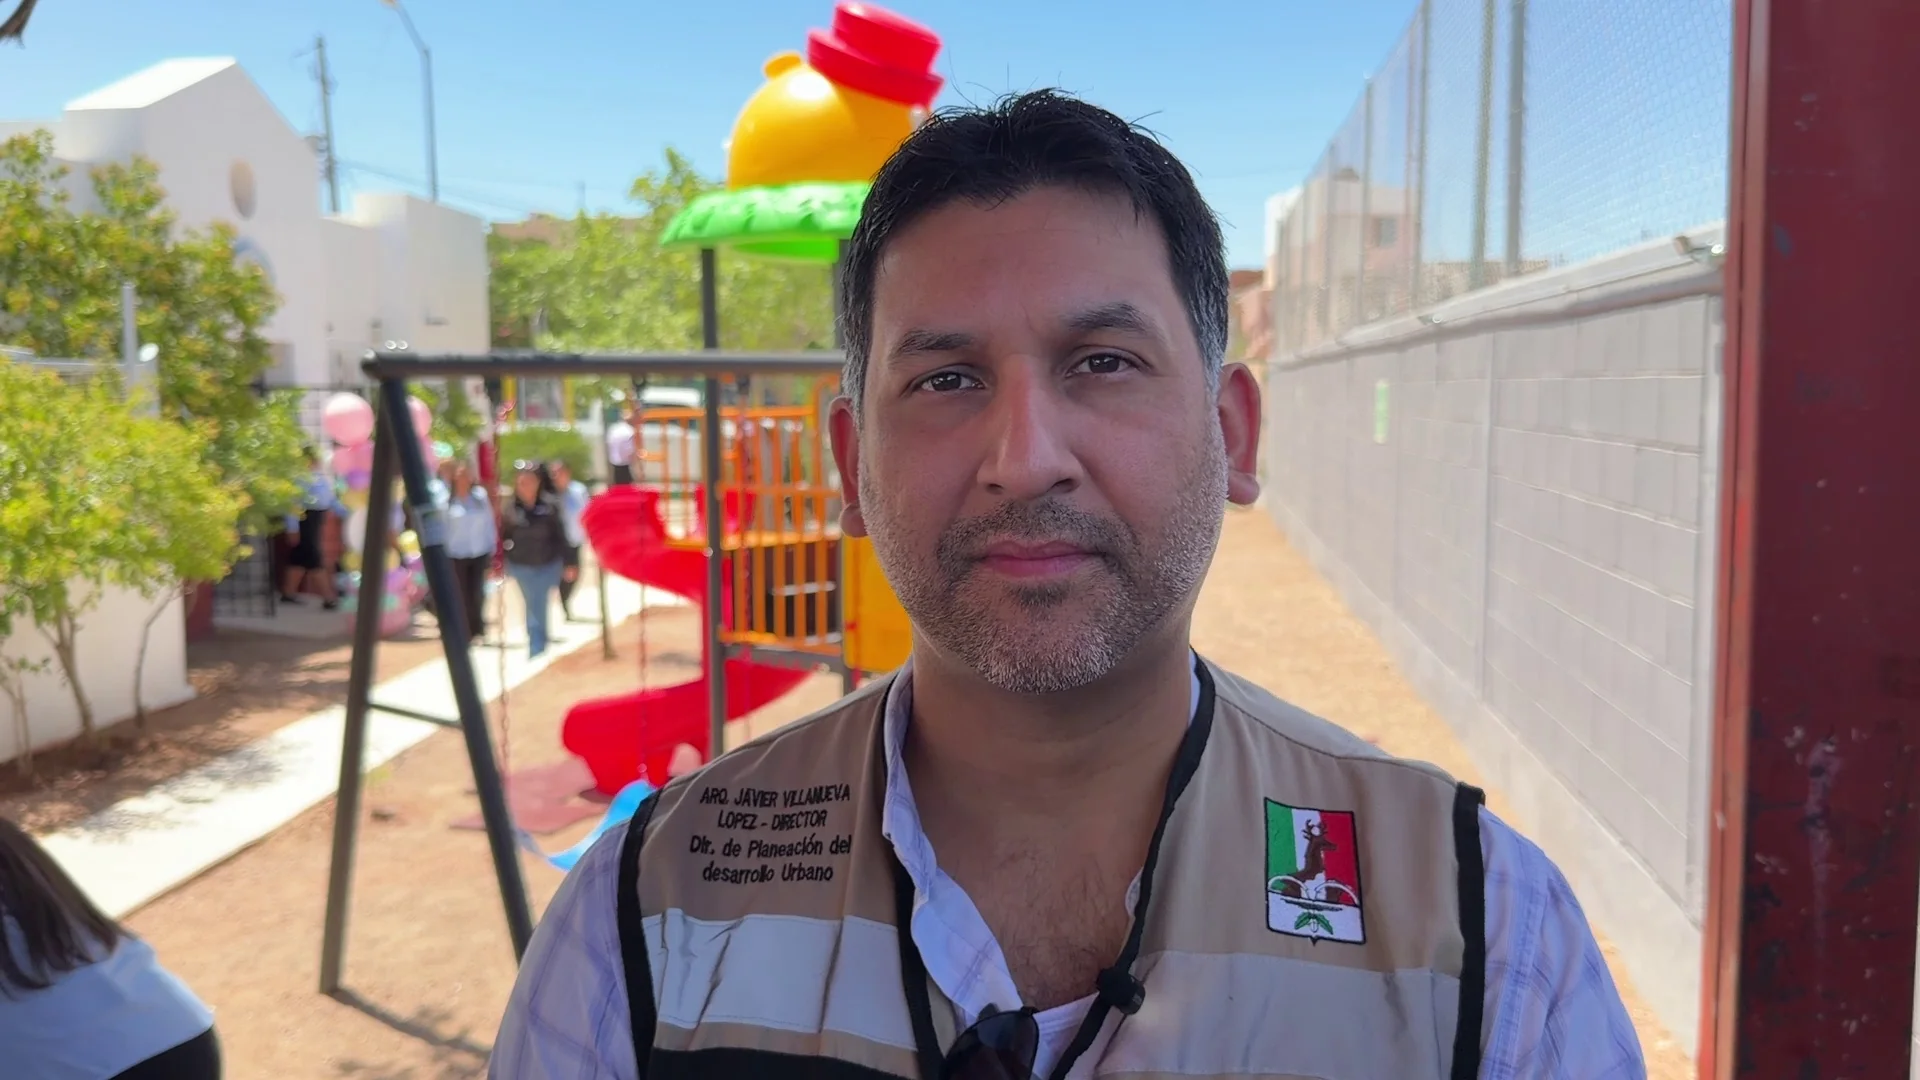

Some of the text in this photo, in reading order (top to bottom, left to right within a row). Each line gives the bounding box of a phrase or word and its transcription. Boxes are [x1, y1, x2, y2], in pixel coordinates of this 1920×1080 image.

[735, 788, 778, 808] JAVIER
[783, 784, 851, 808] VILLANUEVA
[717, 810, 758, 830] LOPEZ
[772, 810, 828, 831] DIRECTOR
[722, 838, 742, 857] de
[747, 832, 824, 858] Planeación
[829, 834, 852, 855] del
[703, 861, 833, 884] desarrollo Urbano
